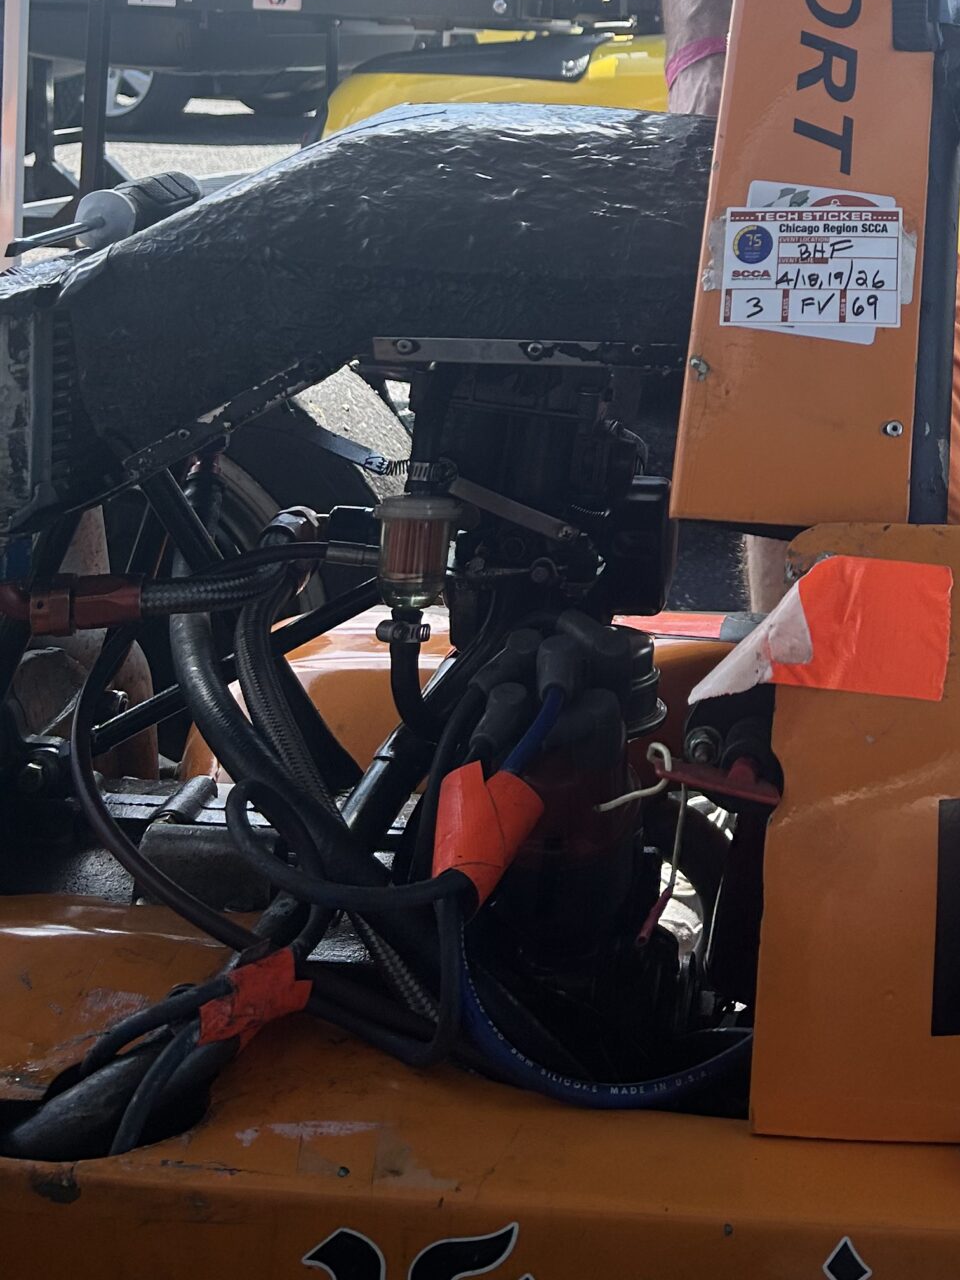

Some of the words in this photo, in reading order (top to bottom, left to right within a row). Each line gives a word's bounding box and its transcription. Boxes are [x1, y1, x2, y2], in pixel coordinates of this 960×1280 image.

[755, 212, 798, 221] TECH
[802, 211, 873, 221] STICKER
[779, 223, 820, 235] Chicago
[823, 223, 858, 235] Region
[861, 223, 889, 233] SCCA
[745, 233, 762, 247] 75
[797, 239, 854, 261] BHF
[732, 269, 771, 278] SCCA
[746, 296, 765, 319] 3
[801, 293, 836, 315] FV
[852, 294, 879, 320] 69
[610, 1085, 646, 1095] MADE
[654, 1081, 668, 1092] IN
